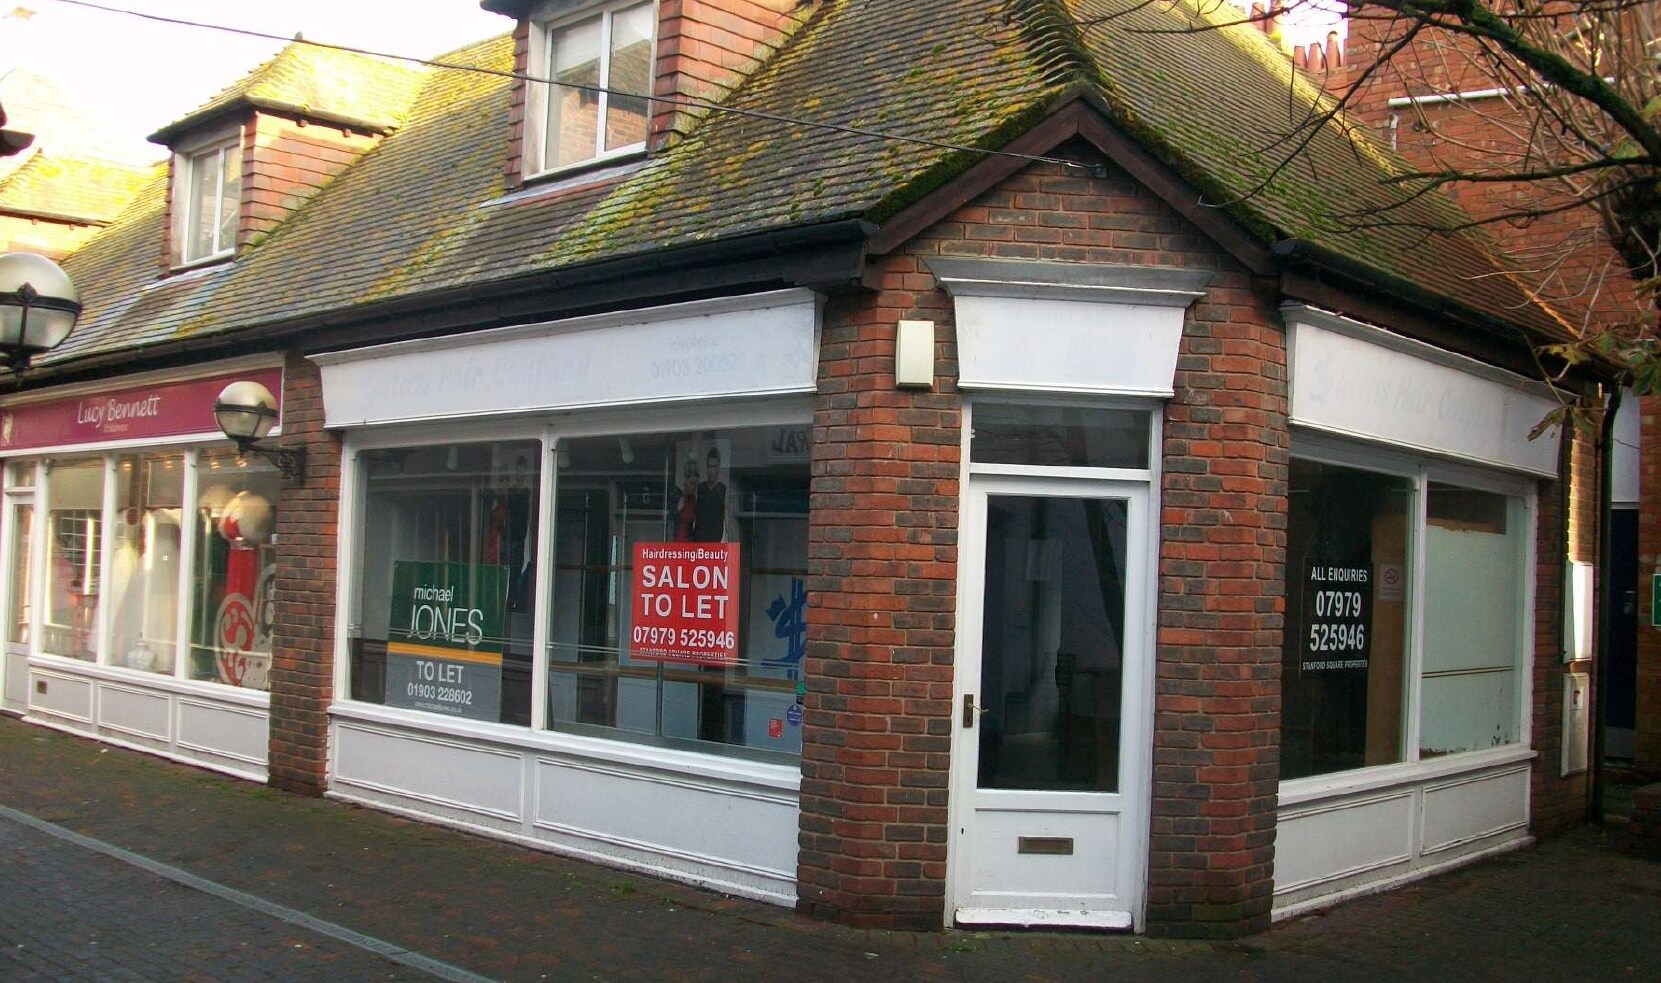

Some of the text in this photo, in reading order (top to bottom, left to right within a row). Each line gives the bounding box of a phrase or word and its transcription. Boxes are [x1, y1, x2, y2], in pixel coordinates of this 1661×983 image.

[77, 395, 161, 428] Lucy Bennett
[642, 564, 728, 590] SALON
[1311, 566, 1368, 582] ALL ENQUIRIES
[413, 584, 454, 602] michael
[641, 593, 729, 619] TO LET
[1316, 590, 1361, 617] 07979
[407, 604, 483, 645] JONES
[633, 626, 735, 649] 07979 525946
[1310, 624, 1364, 651] 525946
[416, 660, 464, 683] TO LET
[407, 682, 473, 705] 01903 228602
